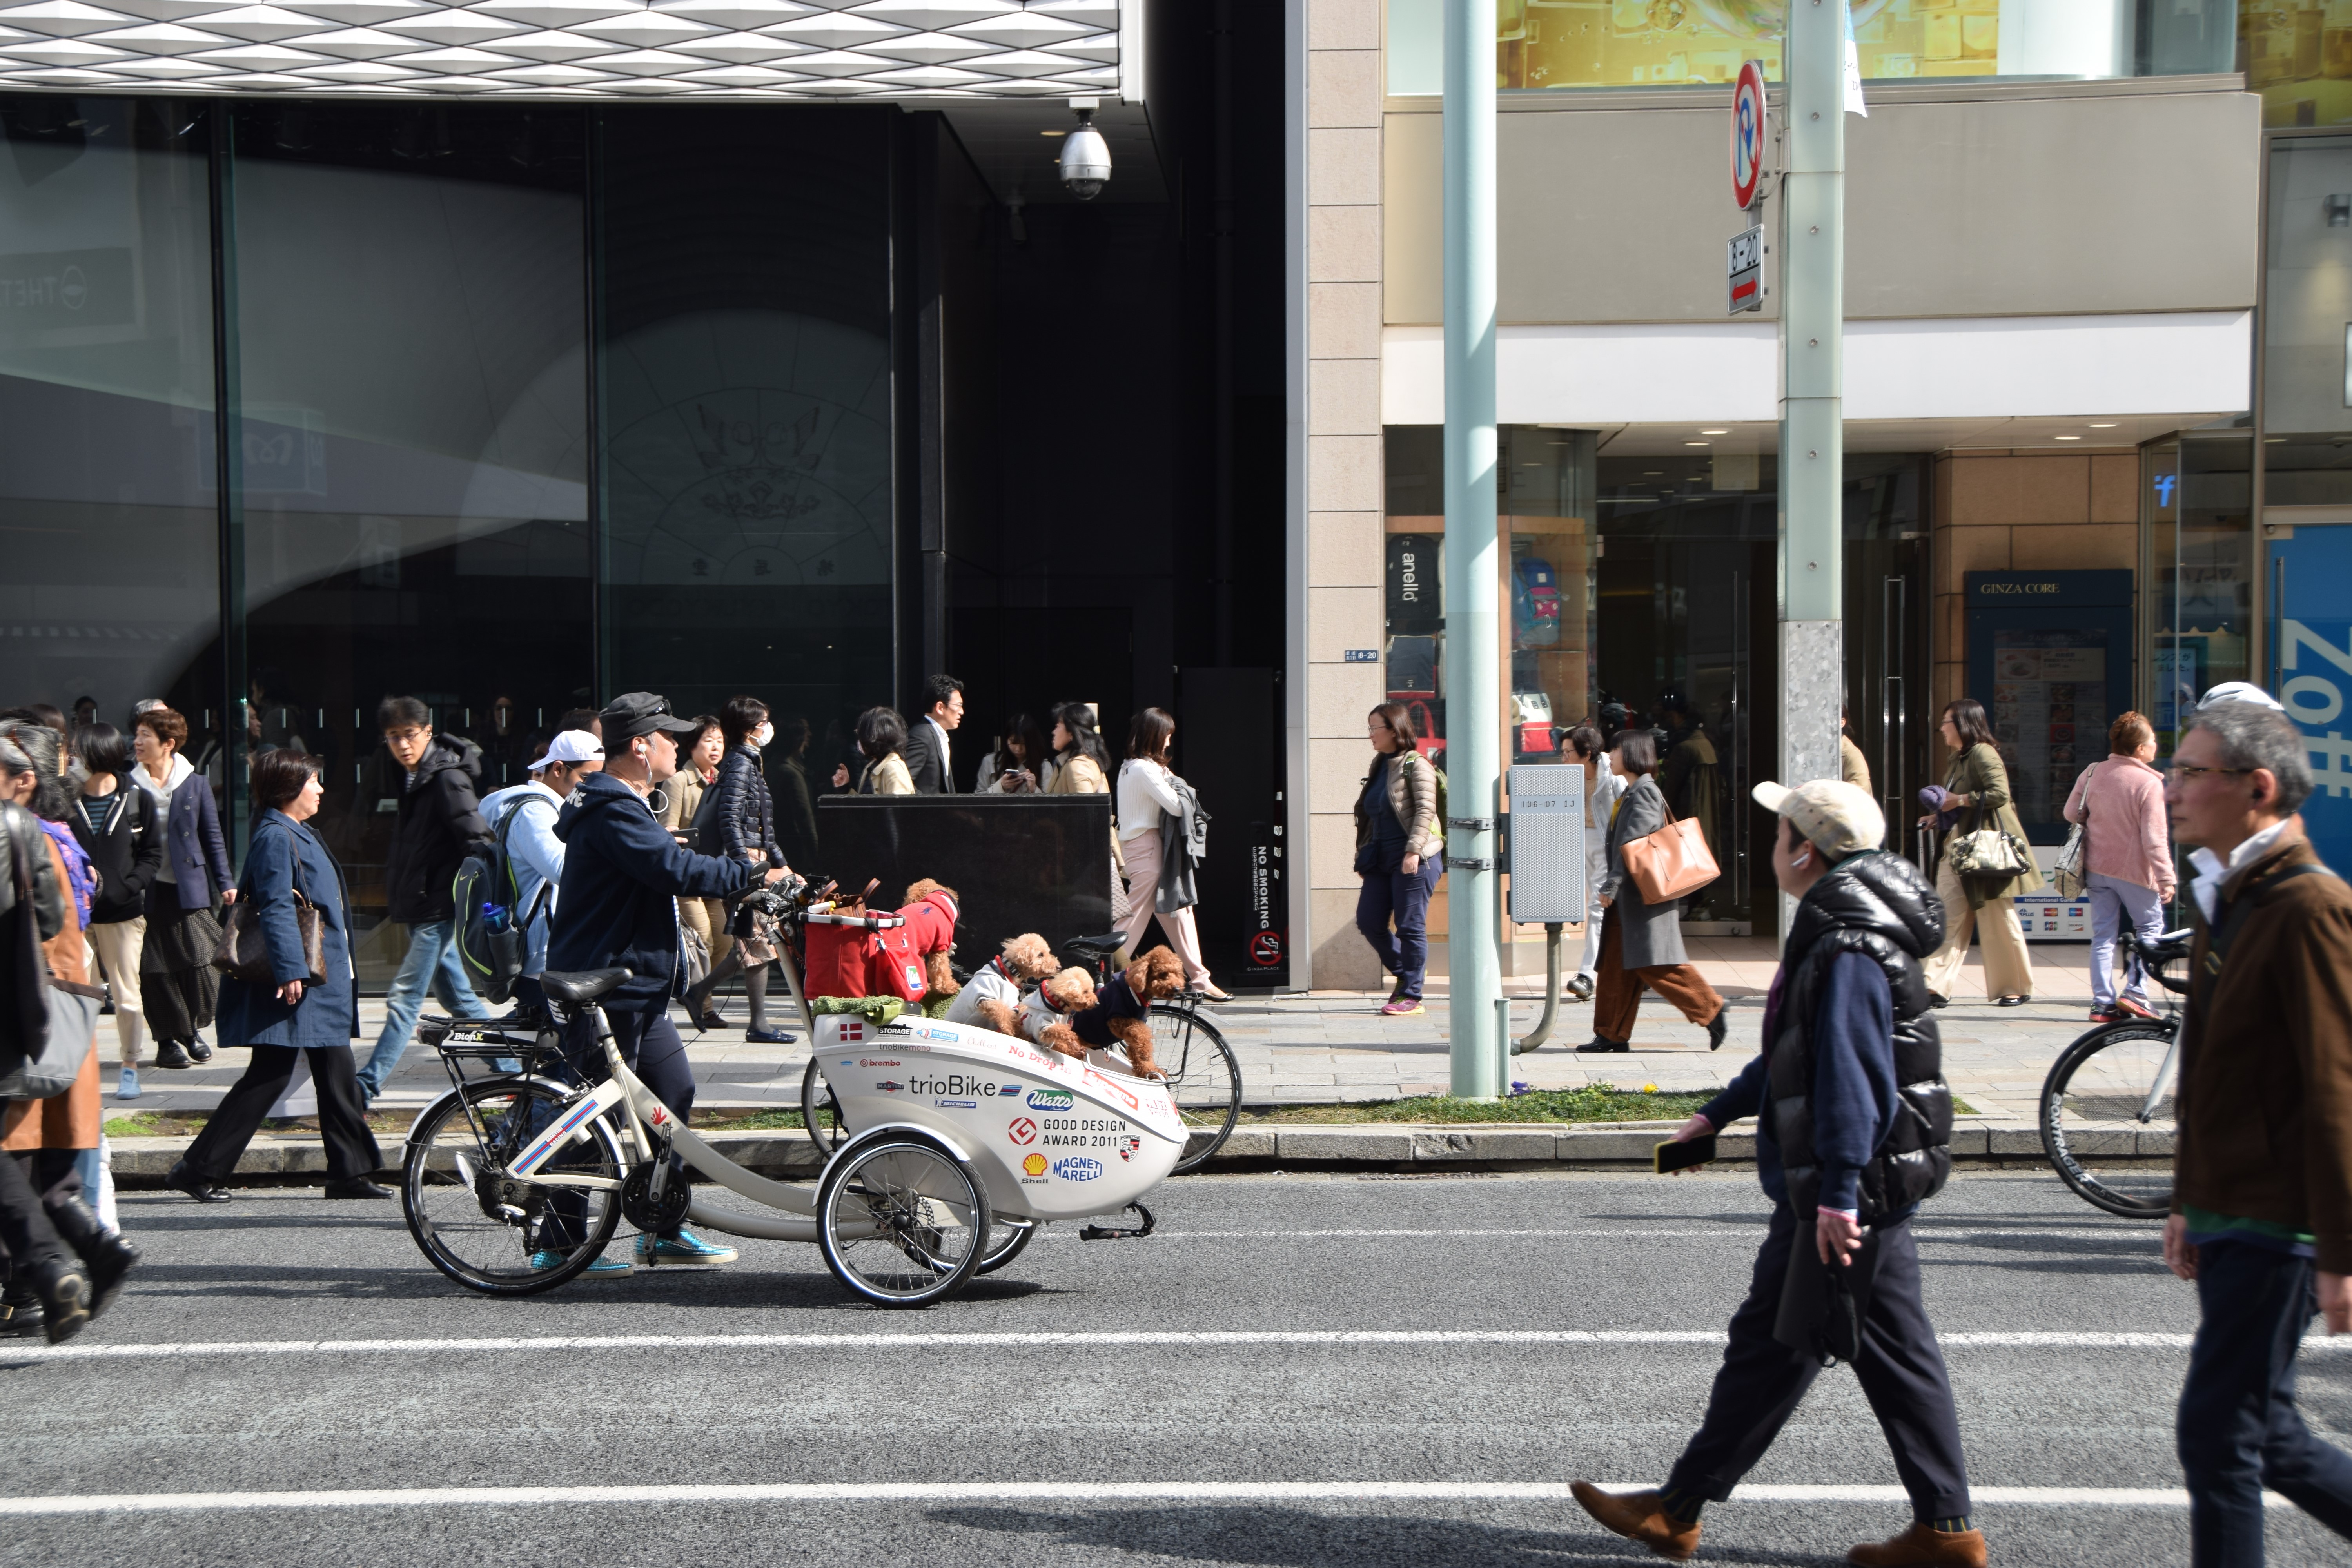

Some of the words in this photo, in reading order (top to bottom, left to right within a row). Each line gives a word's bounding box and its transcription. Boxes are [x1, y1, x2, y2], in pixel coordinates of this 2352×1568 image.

[1401, 552, 1419, 601] anello
[1980, 583, 2021, 594] GINZA
[2025, 583, 2060, 594] CORE
[1257, 846, 1267, 864] NO
[1259, 868, 1269, 929] SMOKING
[454, 1032, 484, 1042] BionX
[932, 1030, 957, 1039] STORAGE
[2104, 1030, 2172, 1045] TRAGER
[1008, 1045, 1025, 1058] No
[1029, 1052, 1057, 1071] Drop
[1060, 1062, 1072, 1075] In
[909, 1074, 996, 1096] trioBike
[1085, 1071, 1136, 1106] Supreme
[1029, 1090, 1074, 1108] Watts
[1044, 1118, 1077, 1130] GOOD
[1081, 1120, 1126, 1131] DESIGN
[546, 1126, 564, 1142] MARTINI
[549, 1131, 568, 1147] RACING
[1042, 1134, 1087, 1146] AWARD
[1091, 1136, 1117, 1147] 2011
[2049, 1091, 2090, 1183] BONTRAGER
[1053, 1156, 1103, 1170] MAGNETI
[1053, 1169, 1103, 1181] MARELLI
